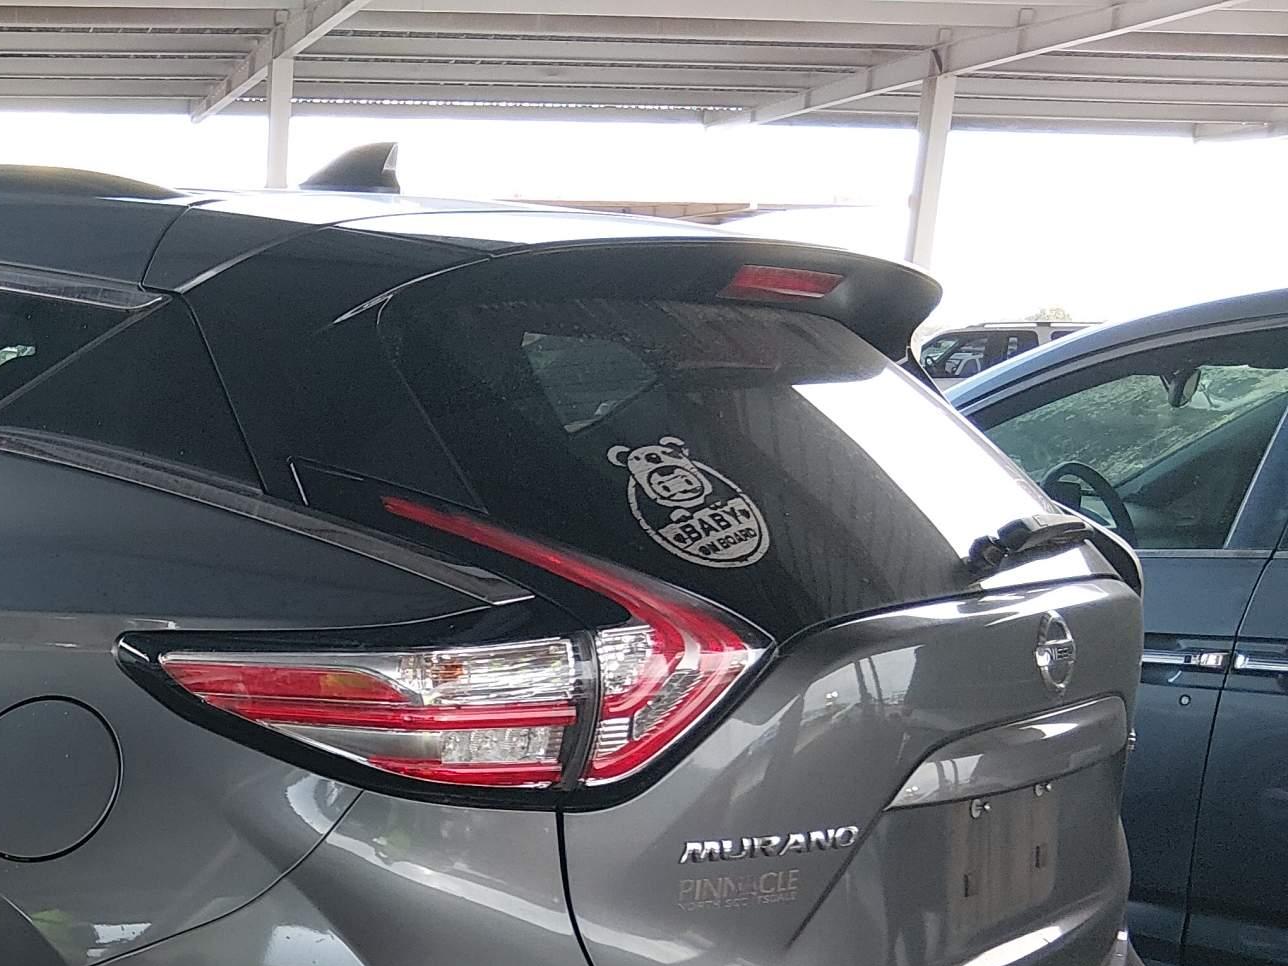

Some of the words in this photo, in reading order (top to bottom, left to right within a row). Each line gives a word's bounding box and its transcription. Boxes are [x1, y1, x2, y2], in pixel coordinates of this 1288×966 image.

[678, 506, 743, 542] BABY
[698, 541, 721, 556] ON
[716, 527, 758, 549] BOARD
[679, 825, 859, 864] MURANO
